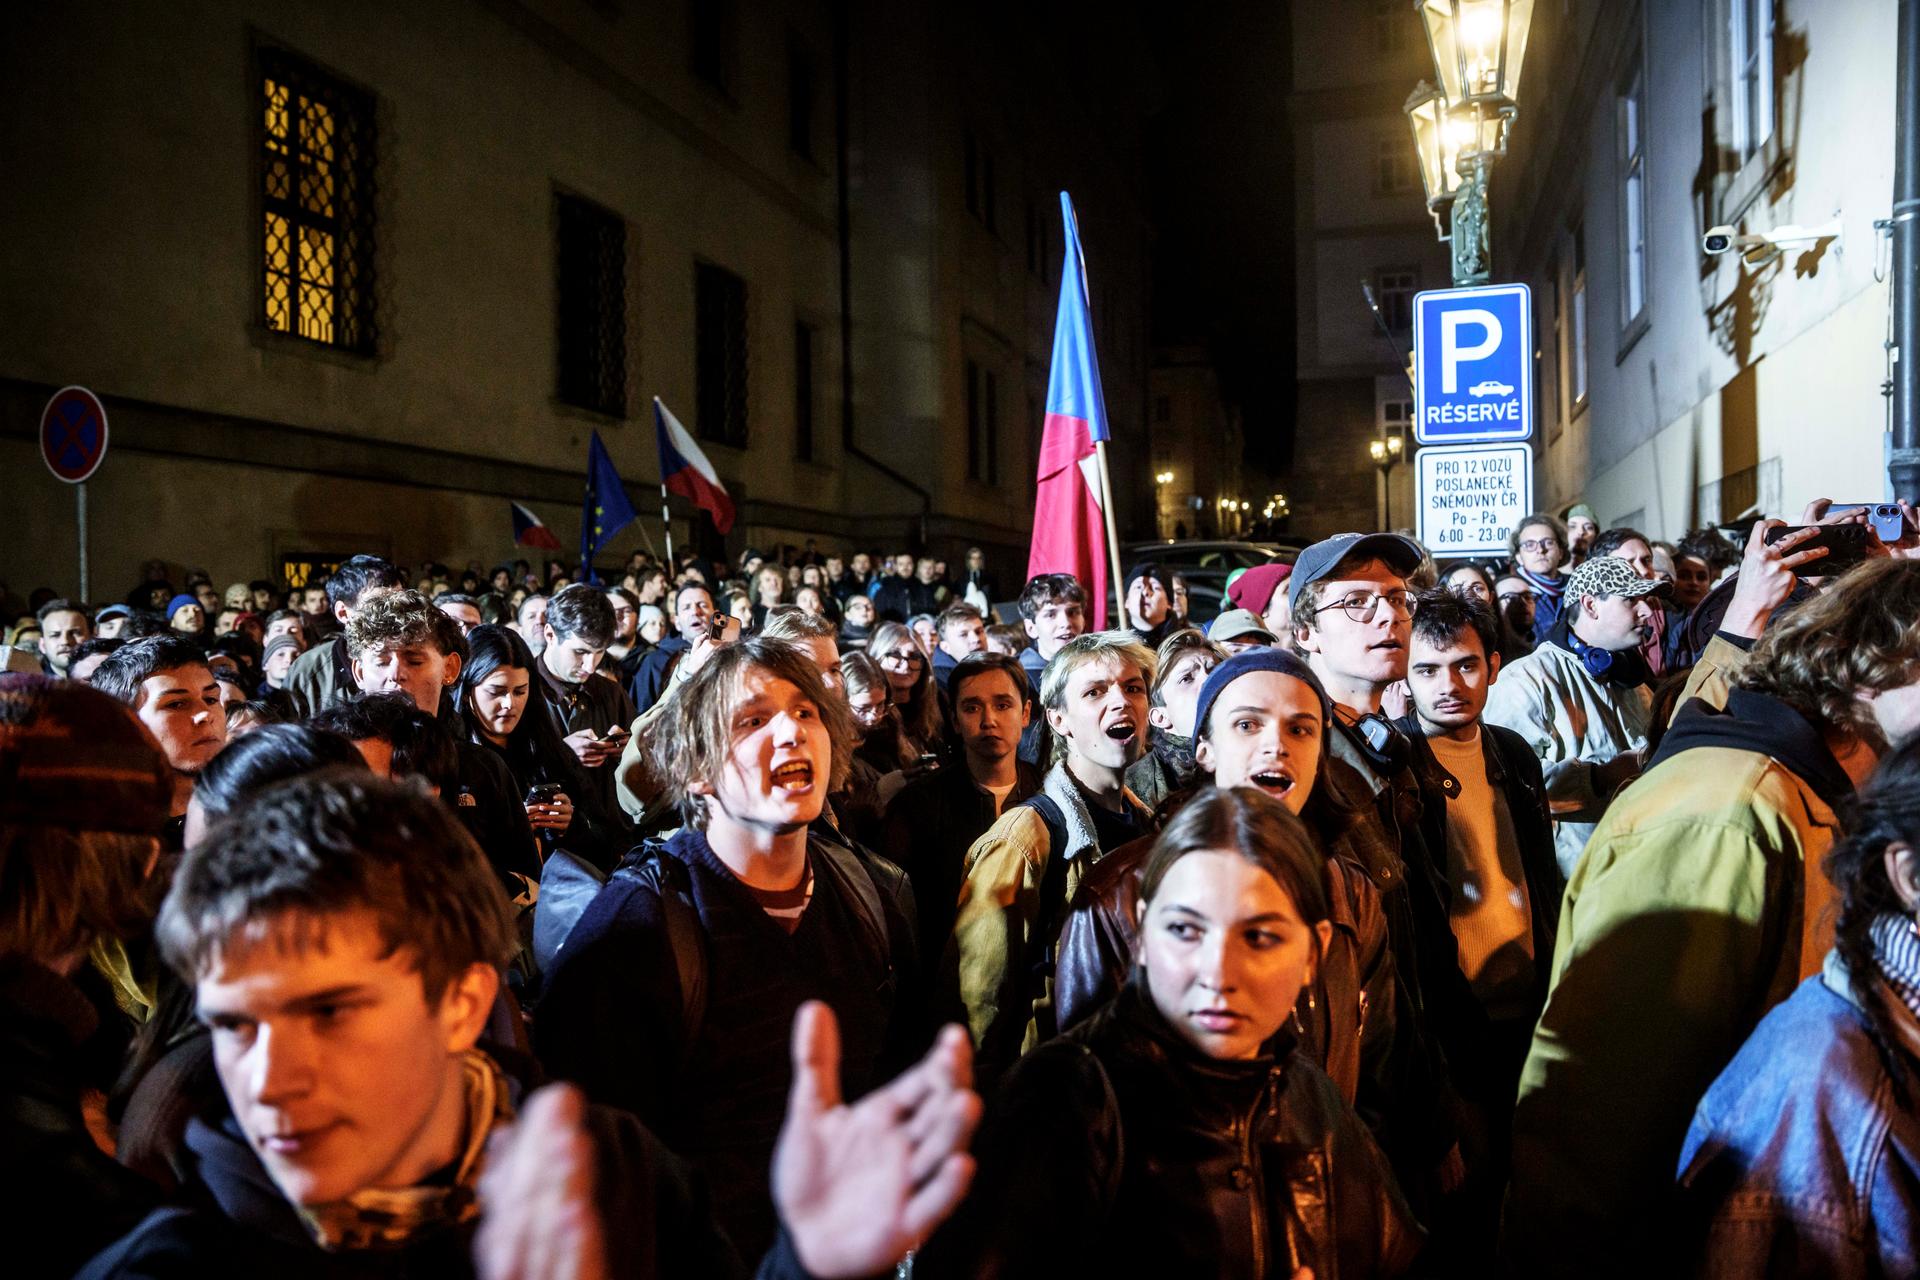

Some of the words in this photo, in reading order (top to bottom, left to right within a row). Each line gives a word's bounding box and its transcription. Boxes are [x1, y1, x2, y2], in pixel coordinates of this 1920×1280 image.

[1441, 309, 1503, 394] P
[1427, 398, 1520, 424] RÉSERVÉ
[1436, 461, 1459, 475] PRO
[1465, 460, 1477, 474] 12
[1436, 473, 1513, 492] POSLANECKÉ
[1432, 492, 1497, 509] SNĚMOVNY
[1501, 490, 1518, 506] ČR
[1452, 512, 1467, 525] Po
[1482, 510, 1497, 524] Pá
[1439, 529, 1463, 543] 6:00
